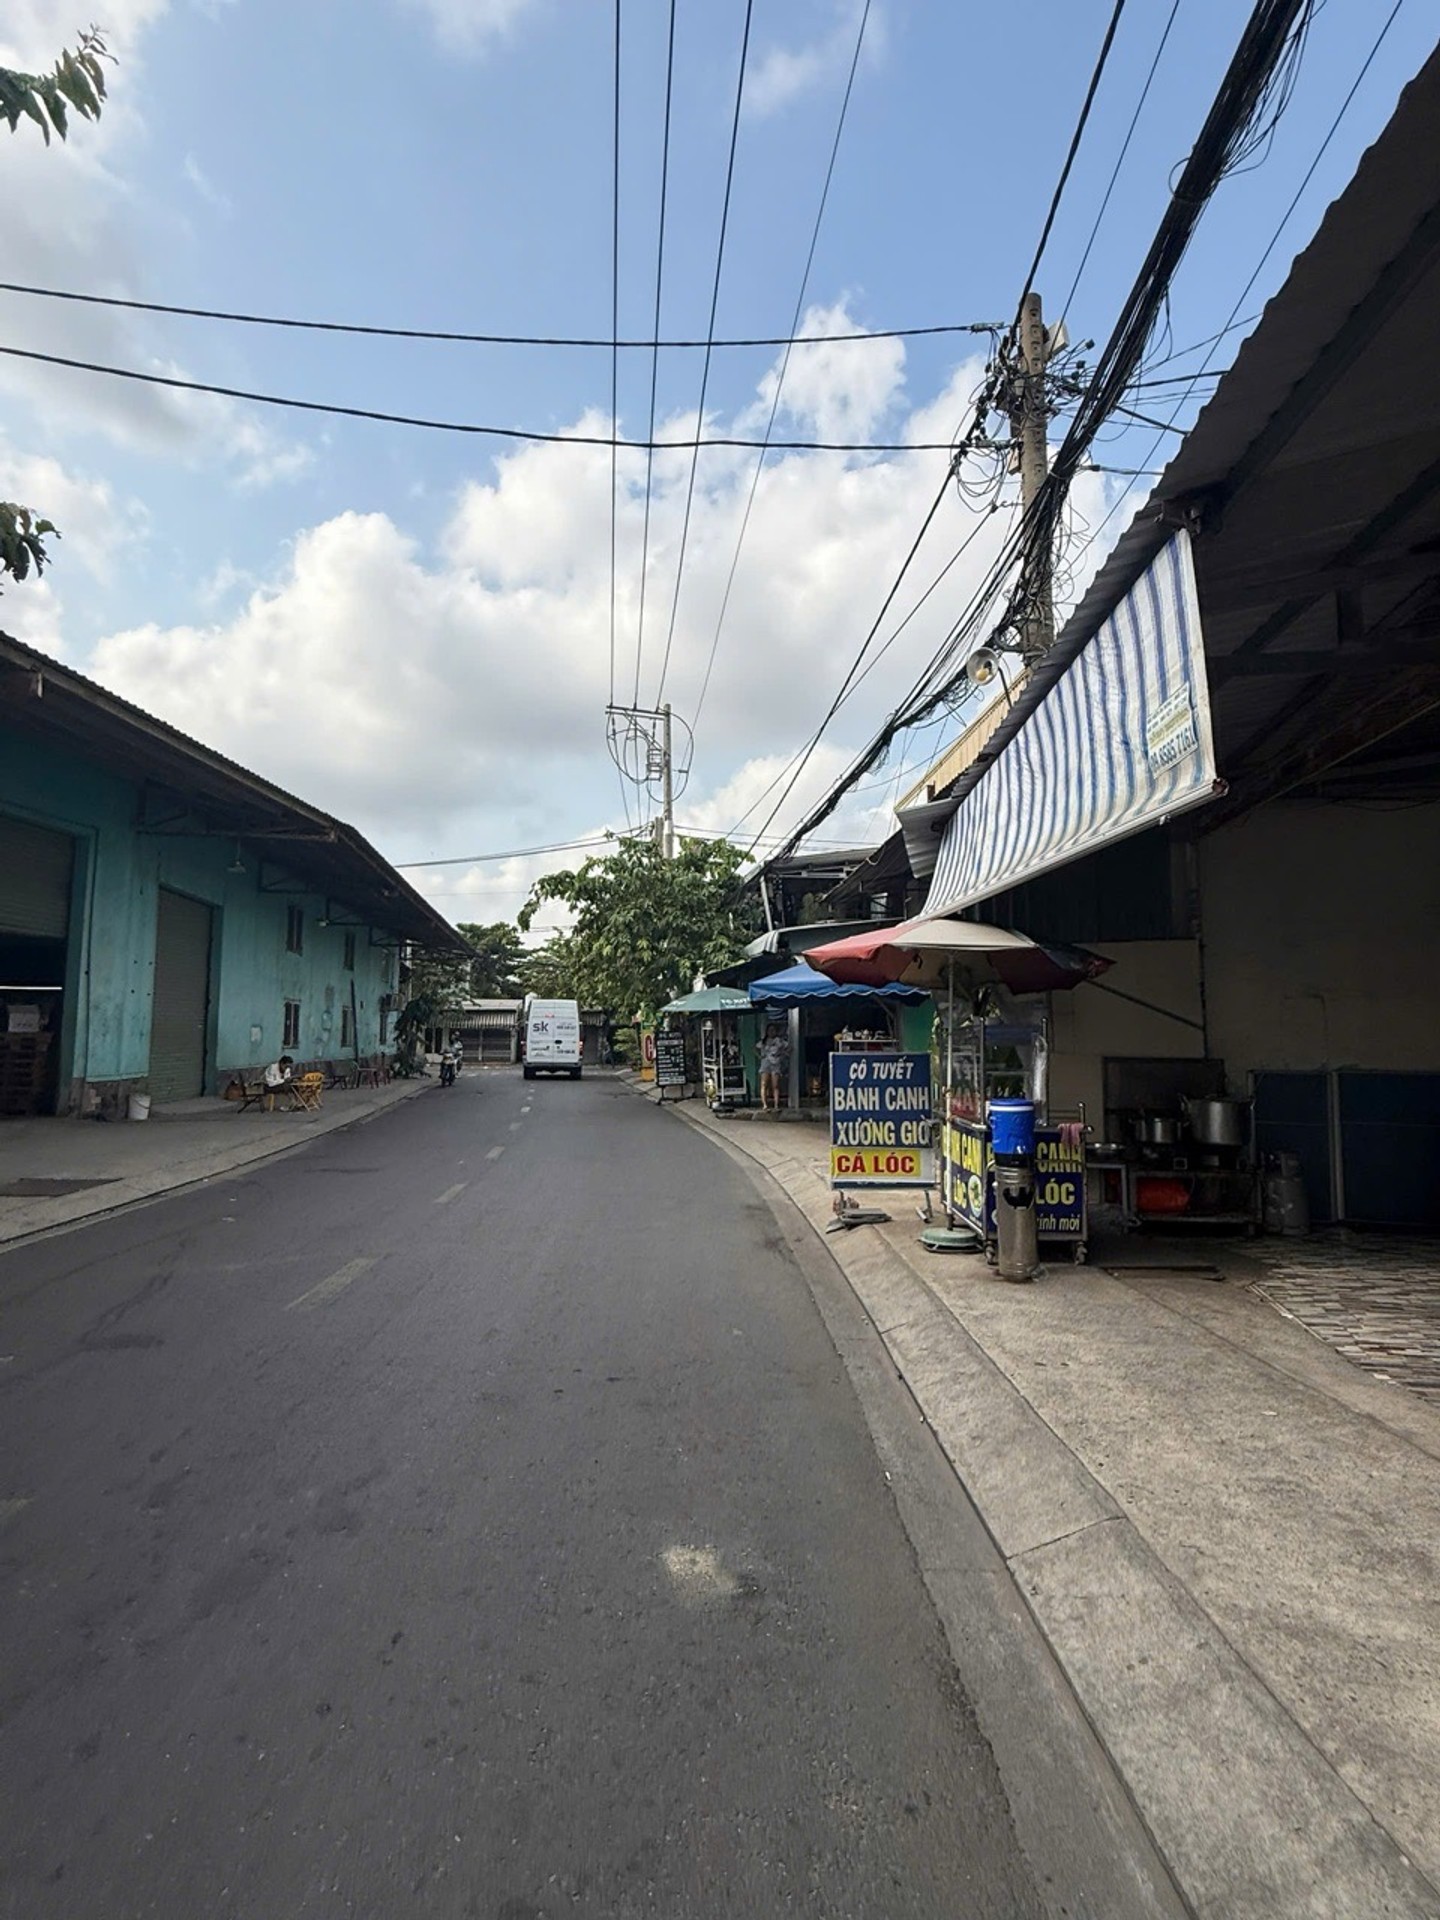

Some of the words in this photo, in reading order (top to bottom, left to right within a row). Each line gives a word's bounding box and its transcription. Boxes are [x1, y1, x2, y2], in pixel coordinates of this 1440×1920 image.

[849, 1058, 867, 1080] CÔ
[872, 1056, 914, 1080] TUYẾT
[834, 1081, 880, 1111] BÁNH
[885, 1086, 930, 1111] CANH
[837, 1116, 896, 1146] XƯƠNG
[836, 1153, 867, 1173] CÁ
[873, 1153, 915, 1174] LÓC
[1036, 1142, 1082, 1173] CANH
[1037, 1213, 1056, 1230] ính
[1059, 1213, 1080, 1230] mời
